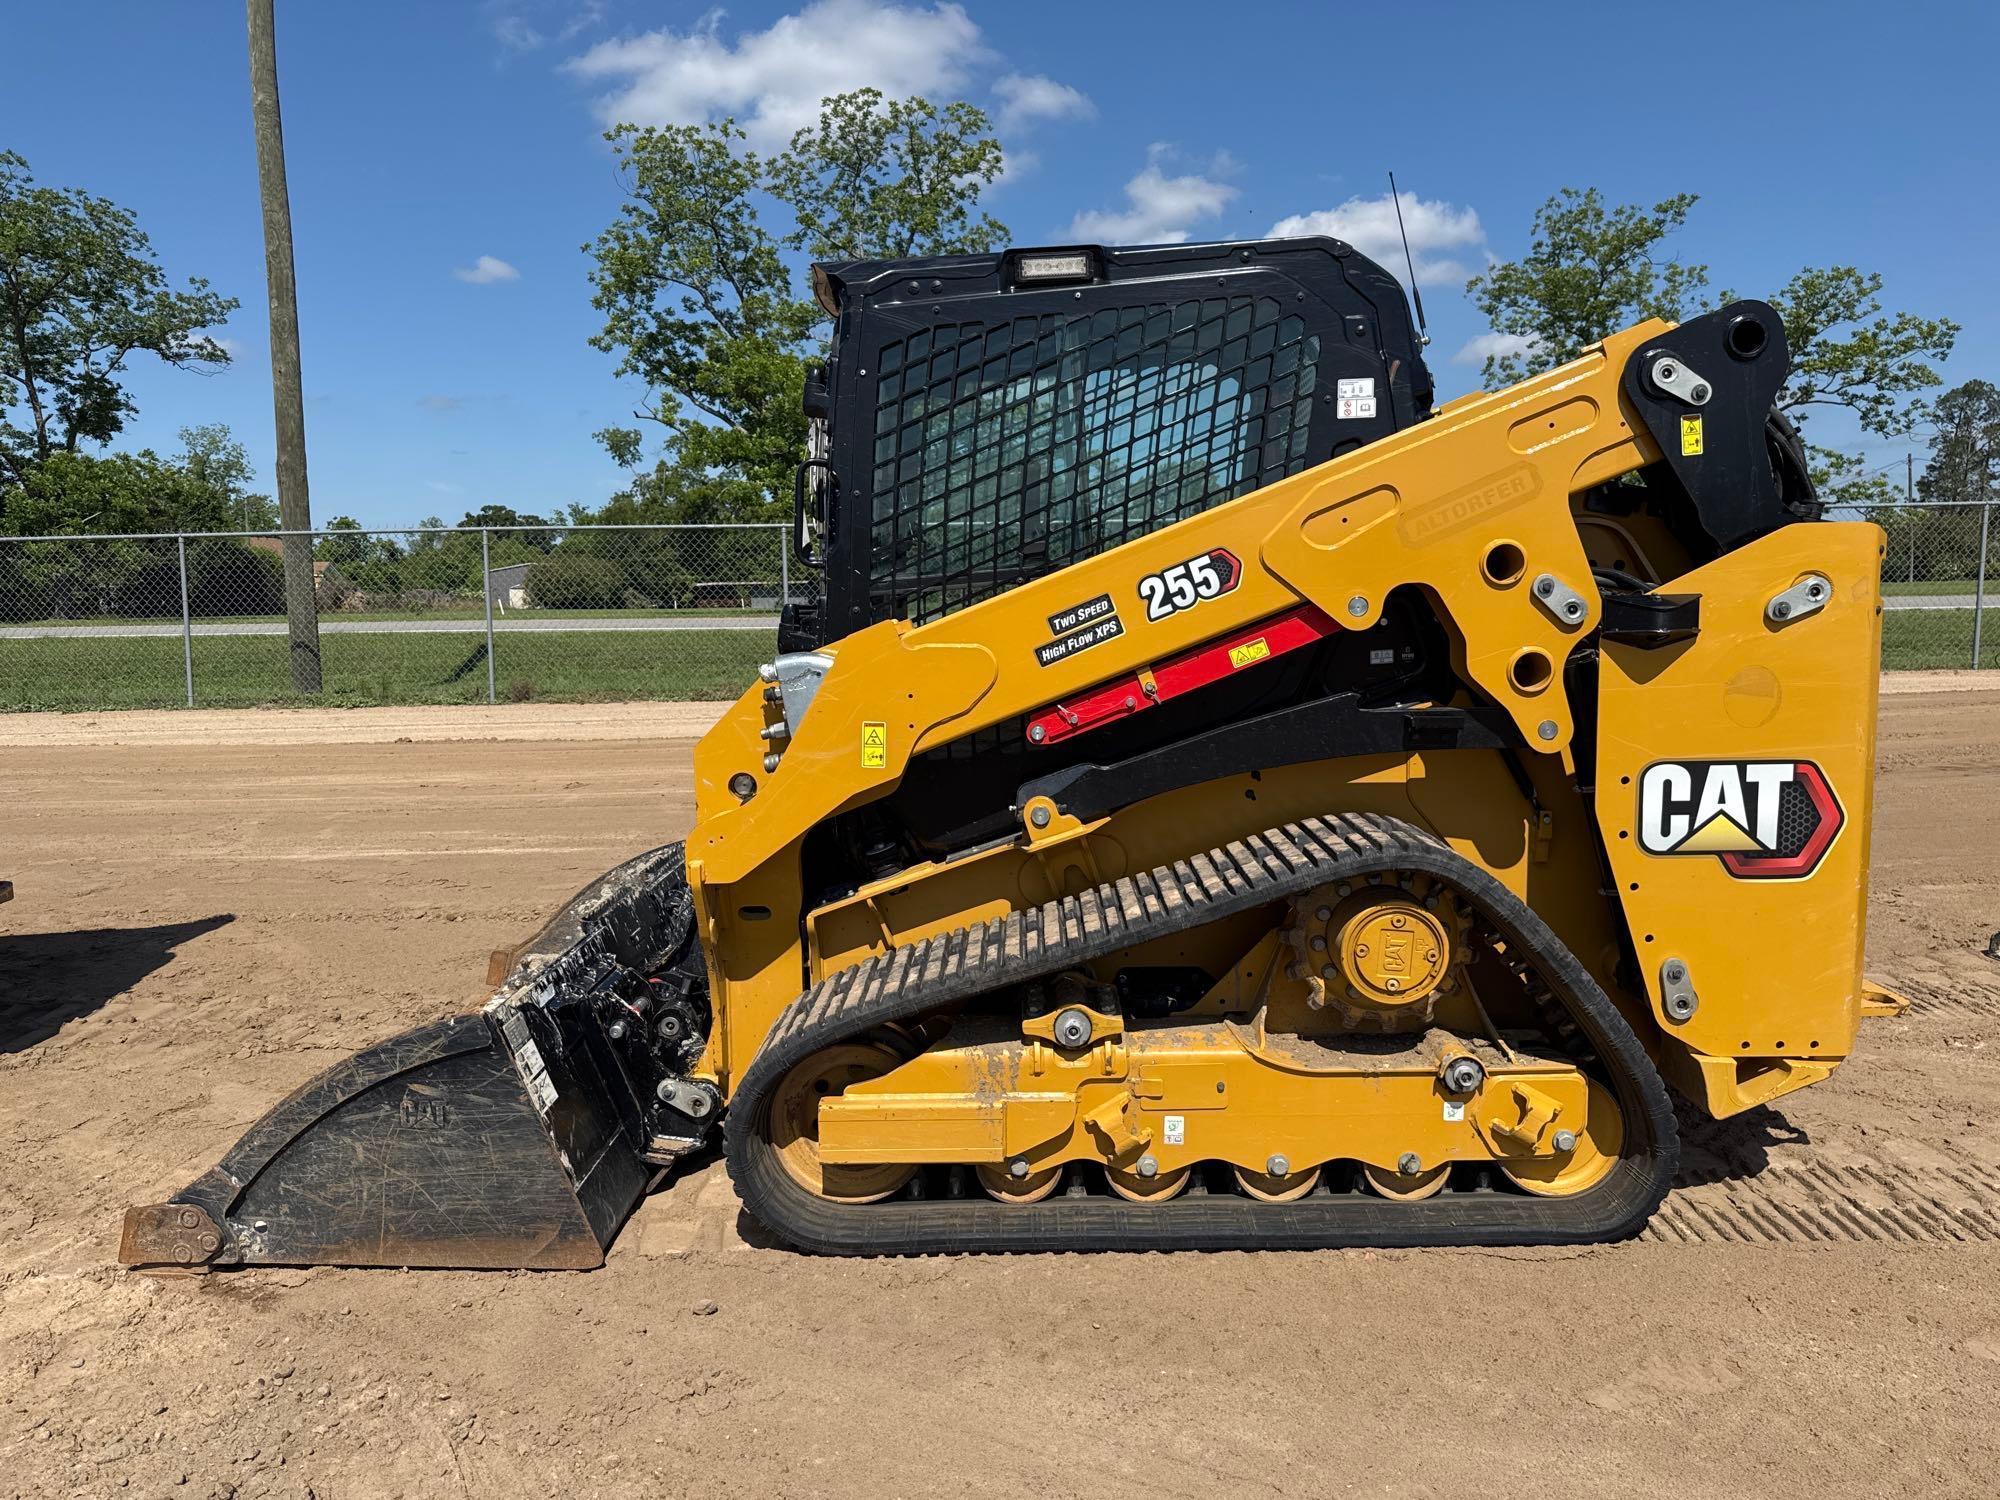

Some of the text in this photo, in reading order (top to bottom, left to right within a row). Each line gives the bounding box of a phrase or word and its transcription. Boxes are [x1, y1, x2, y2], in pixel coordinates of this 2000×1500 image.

[1416, 476, 1525, 535] ALTORFER
[1140, 555, 1221, 619] 255
[1095, 620, 1117, 639] XPS
[1641, 763, 1795, 851] CAT
[1383, 937, 1407, 972] CAT
[400, 1099, 447, 1129] CAT
